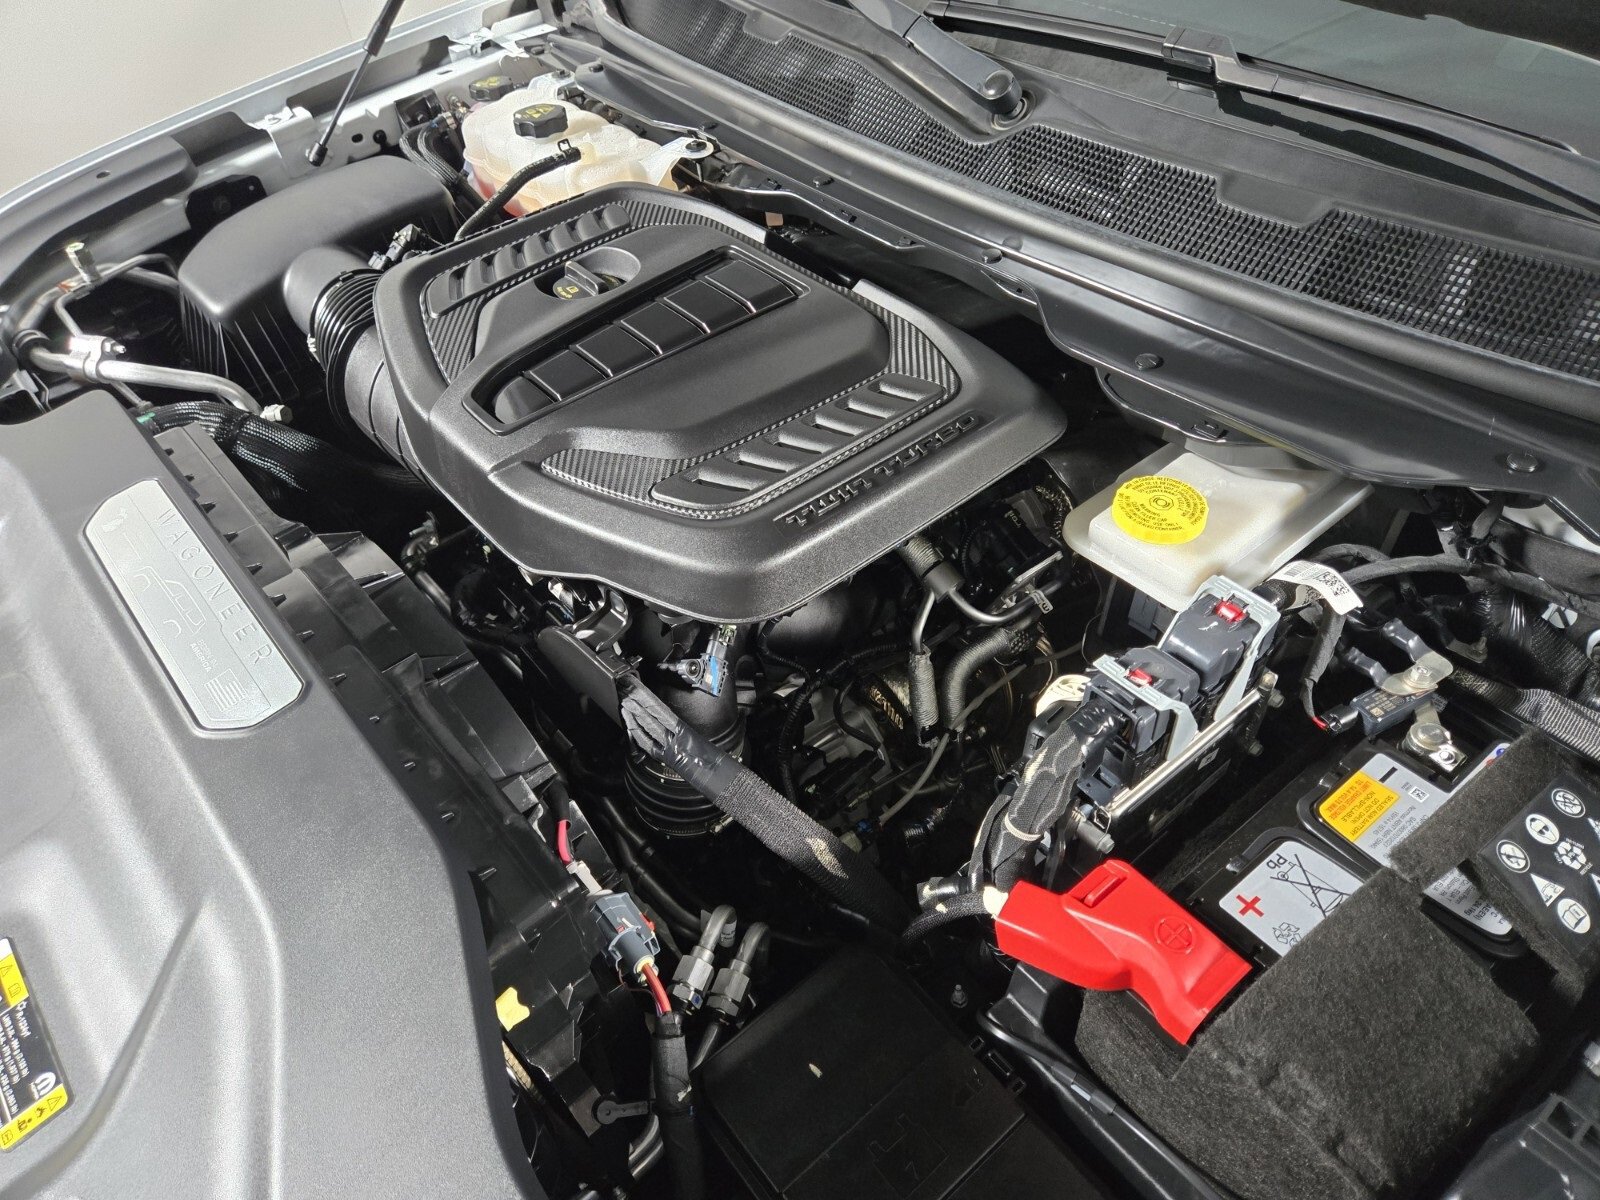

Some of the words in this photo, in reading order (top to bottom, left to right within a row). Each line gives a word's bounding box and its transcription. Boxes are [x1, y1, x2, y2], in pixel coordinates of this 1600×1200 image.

[874, 416, 976, 476] TURBO
[155, 508, 272, 664] WAGONEER
[1370, 797, 1380, 805] DO
[1349, 817, 1369, 836] BATTERY
[1266, 853, 1288, 870] Pb
